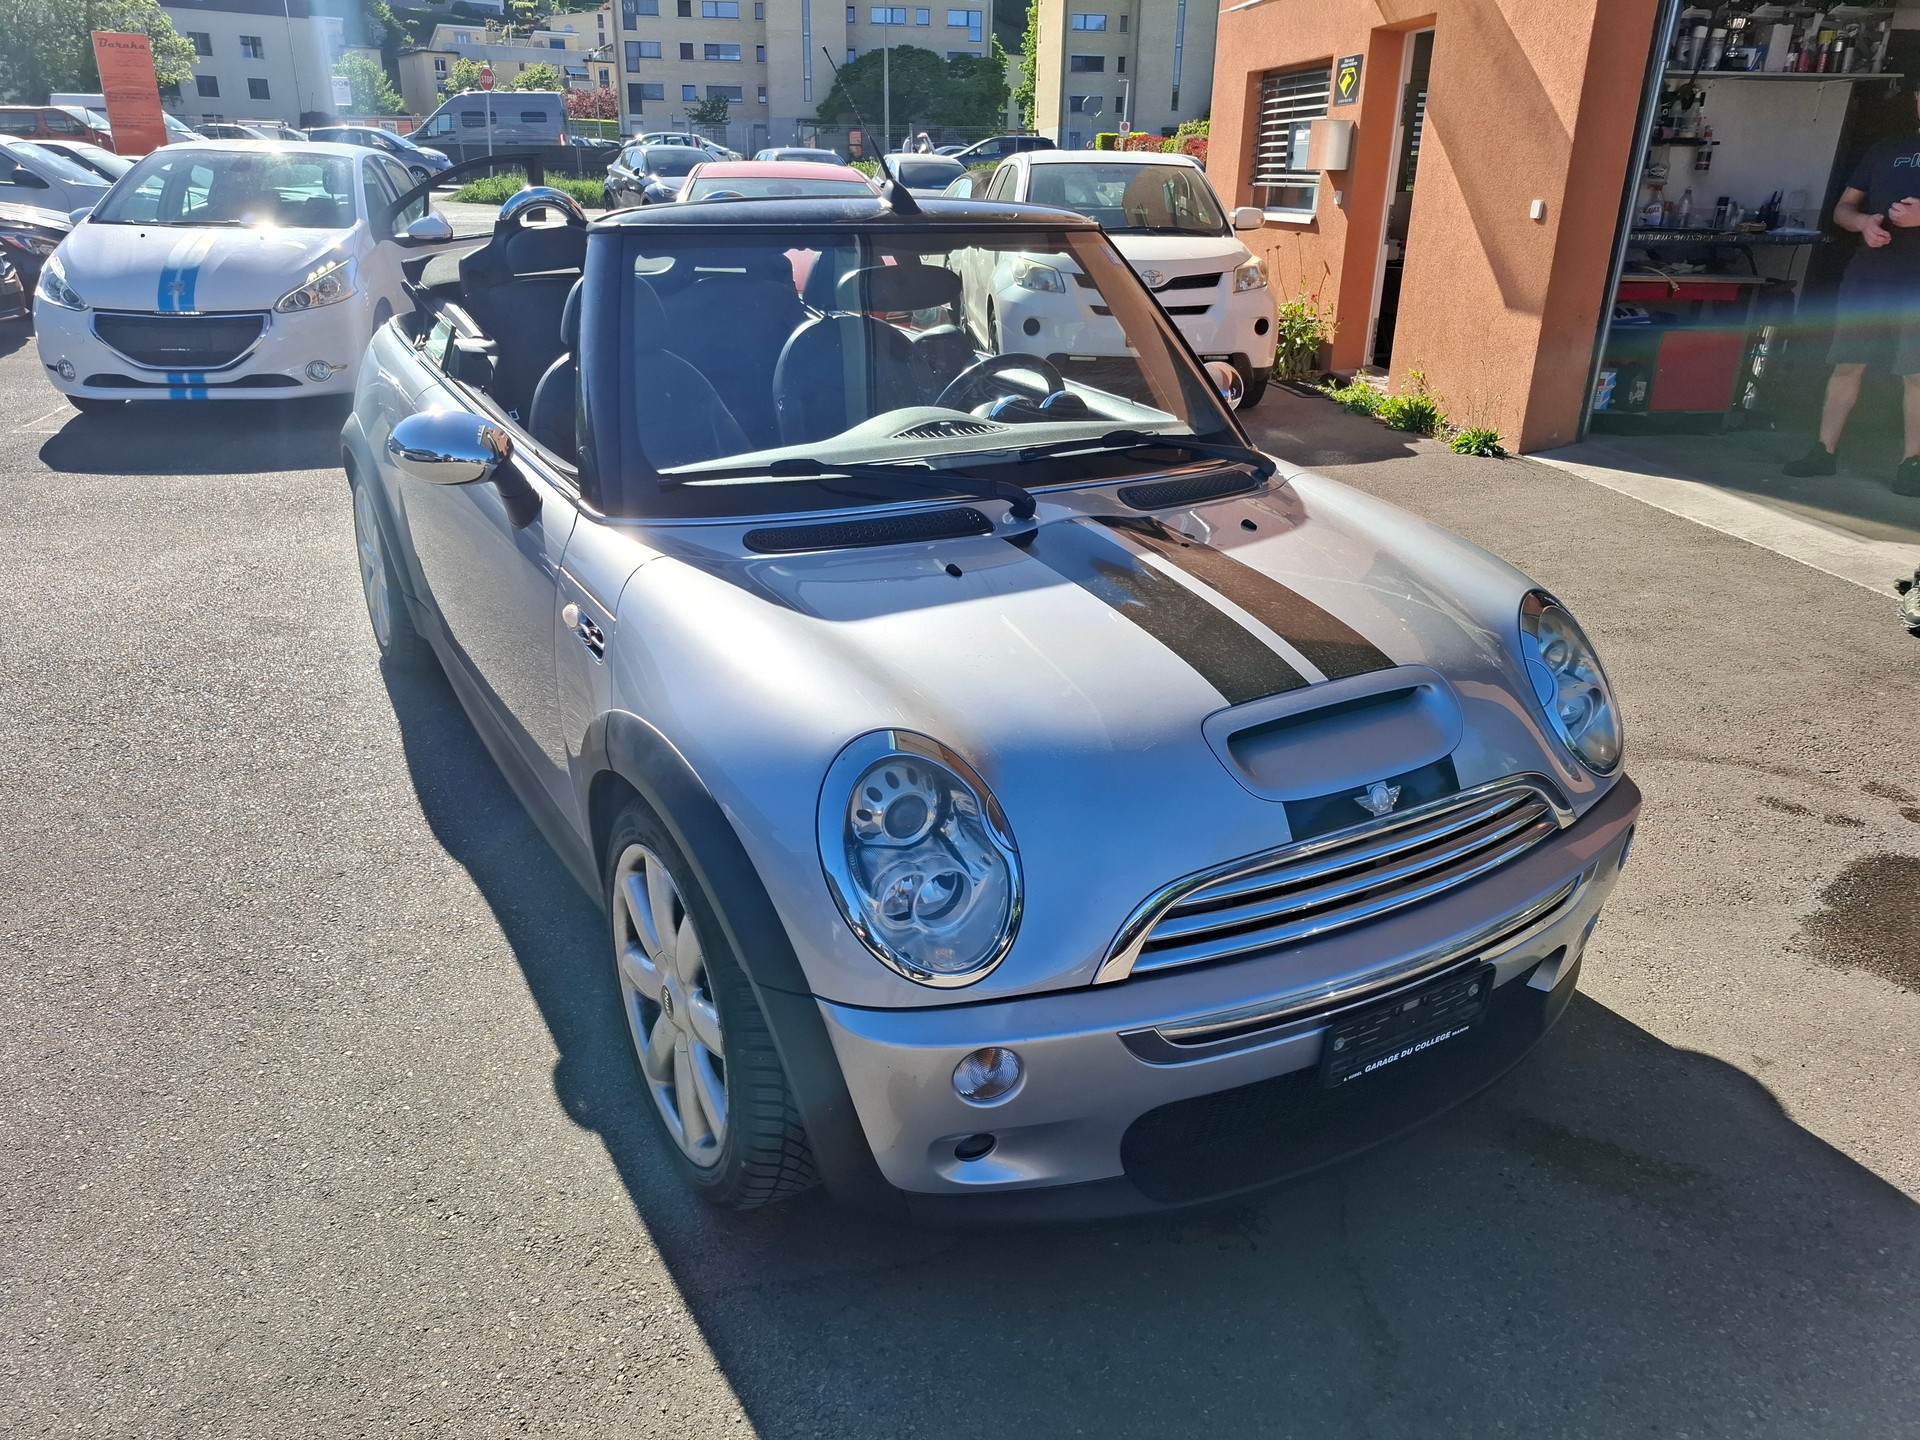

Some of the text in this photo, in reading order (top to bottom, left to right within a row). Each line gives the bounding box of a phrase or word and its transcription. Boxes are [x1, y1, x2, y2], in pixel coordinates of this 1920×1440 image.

[481, 75, 493, 84] STOP
[1364, 1052, 1400, 1073] GARAGE
[1400, 1047, 1414, 1058] DU
[1414, 1031, 1452, 1052] COLLEGE
